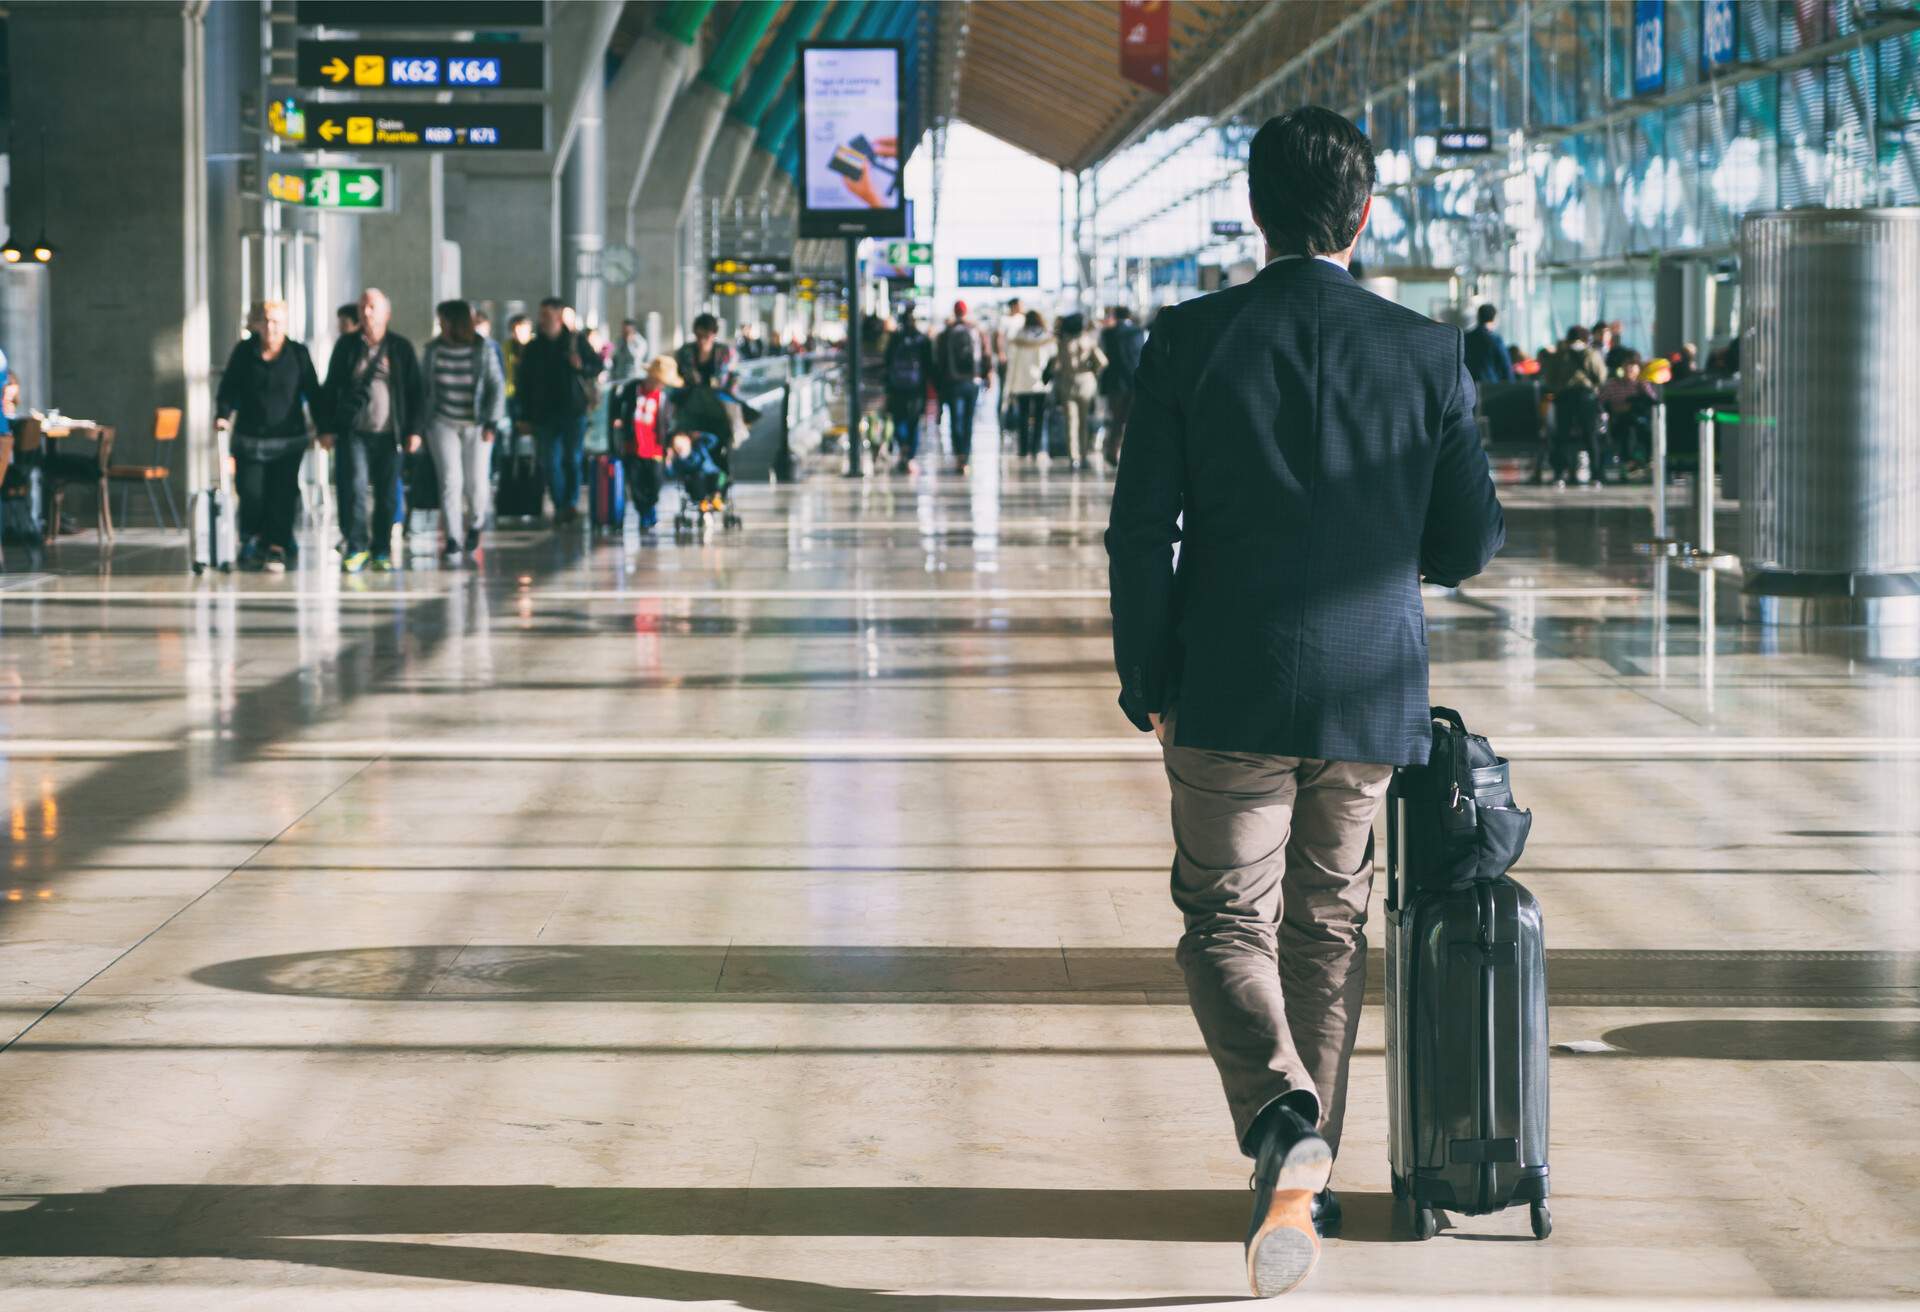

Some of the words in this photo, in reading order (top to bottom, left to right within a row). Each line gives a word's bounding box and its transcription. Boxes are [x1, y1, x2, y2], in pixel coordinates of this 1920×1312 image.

[391, 60, 437, 82] K62
[448, 60, 497, 83] K64
[469, 127, 496, 143] K71
